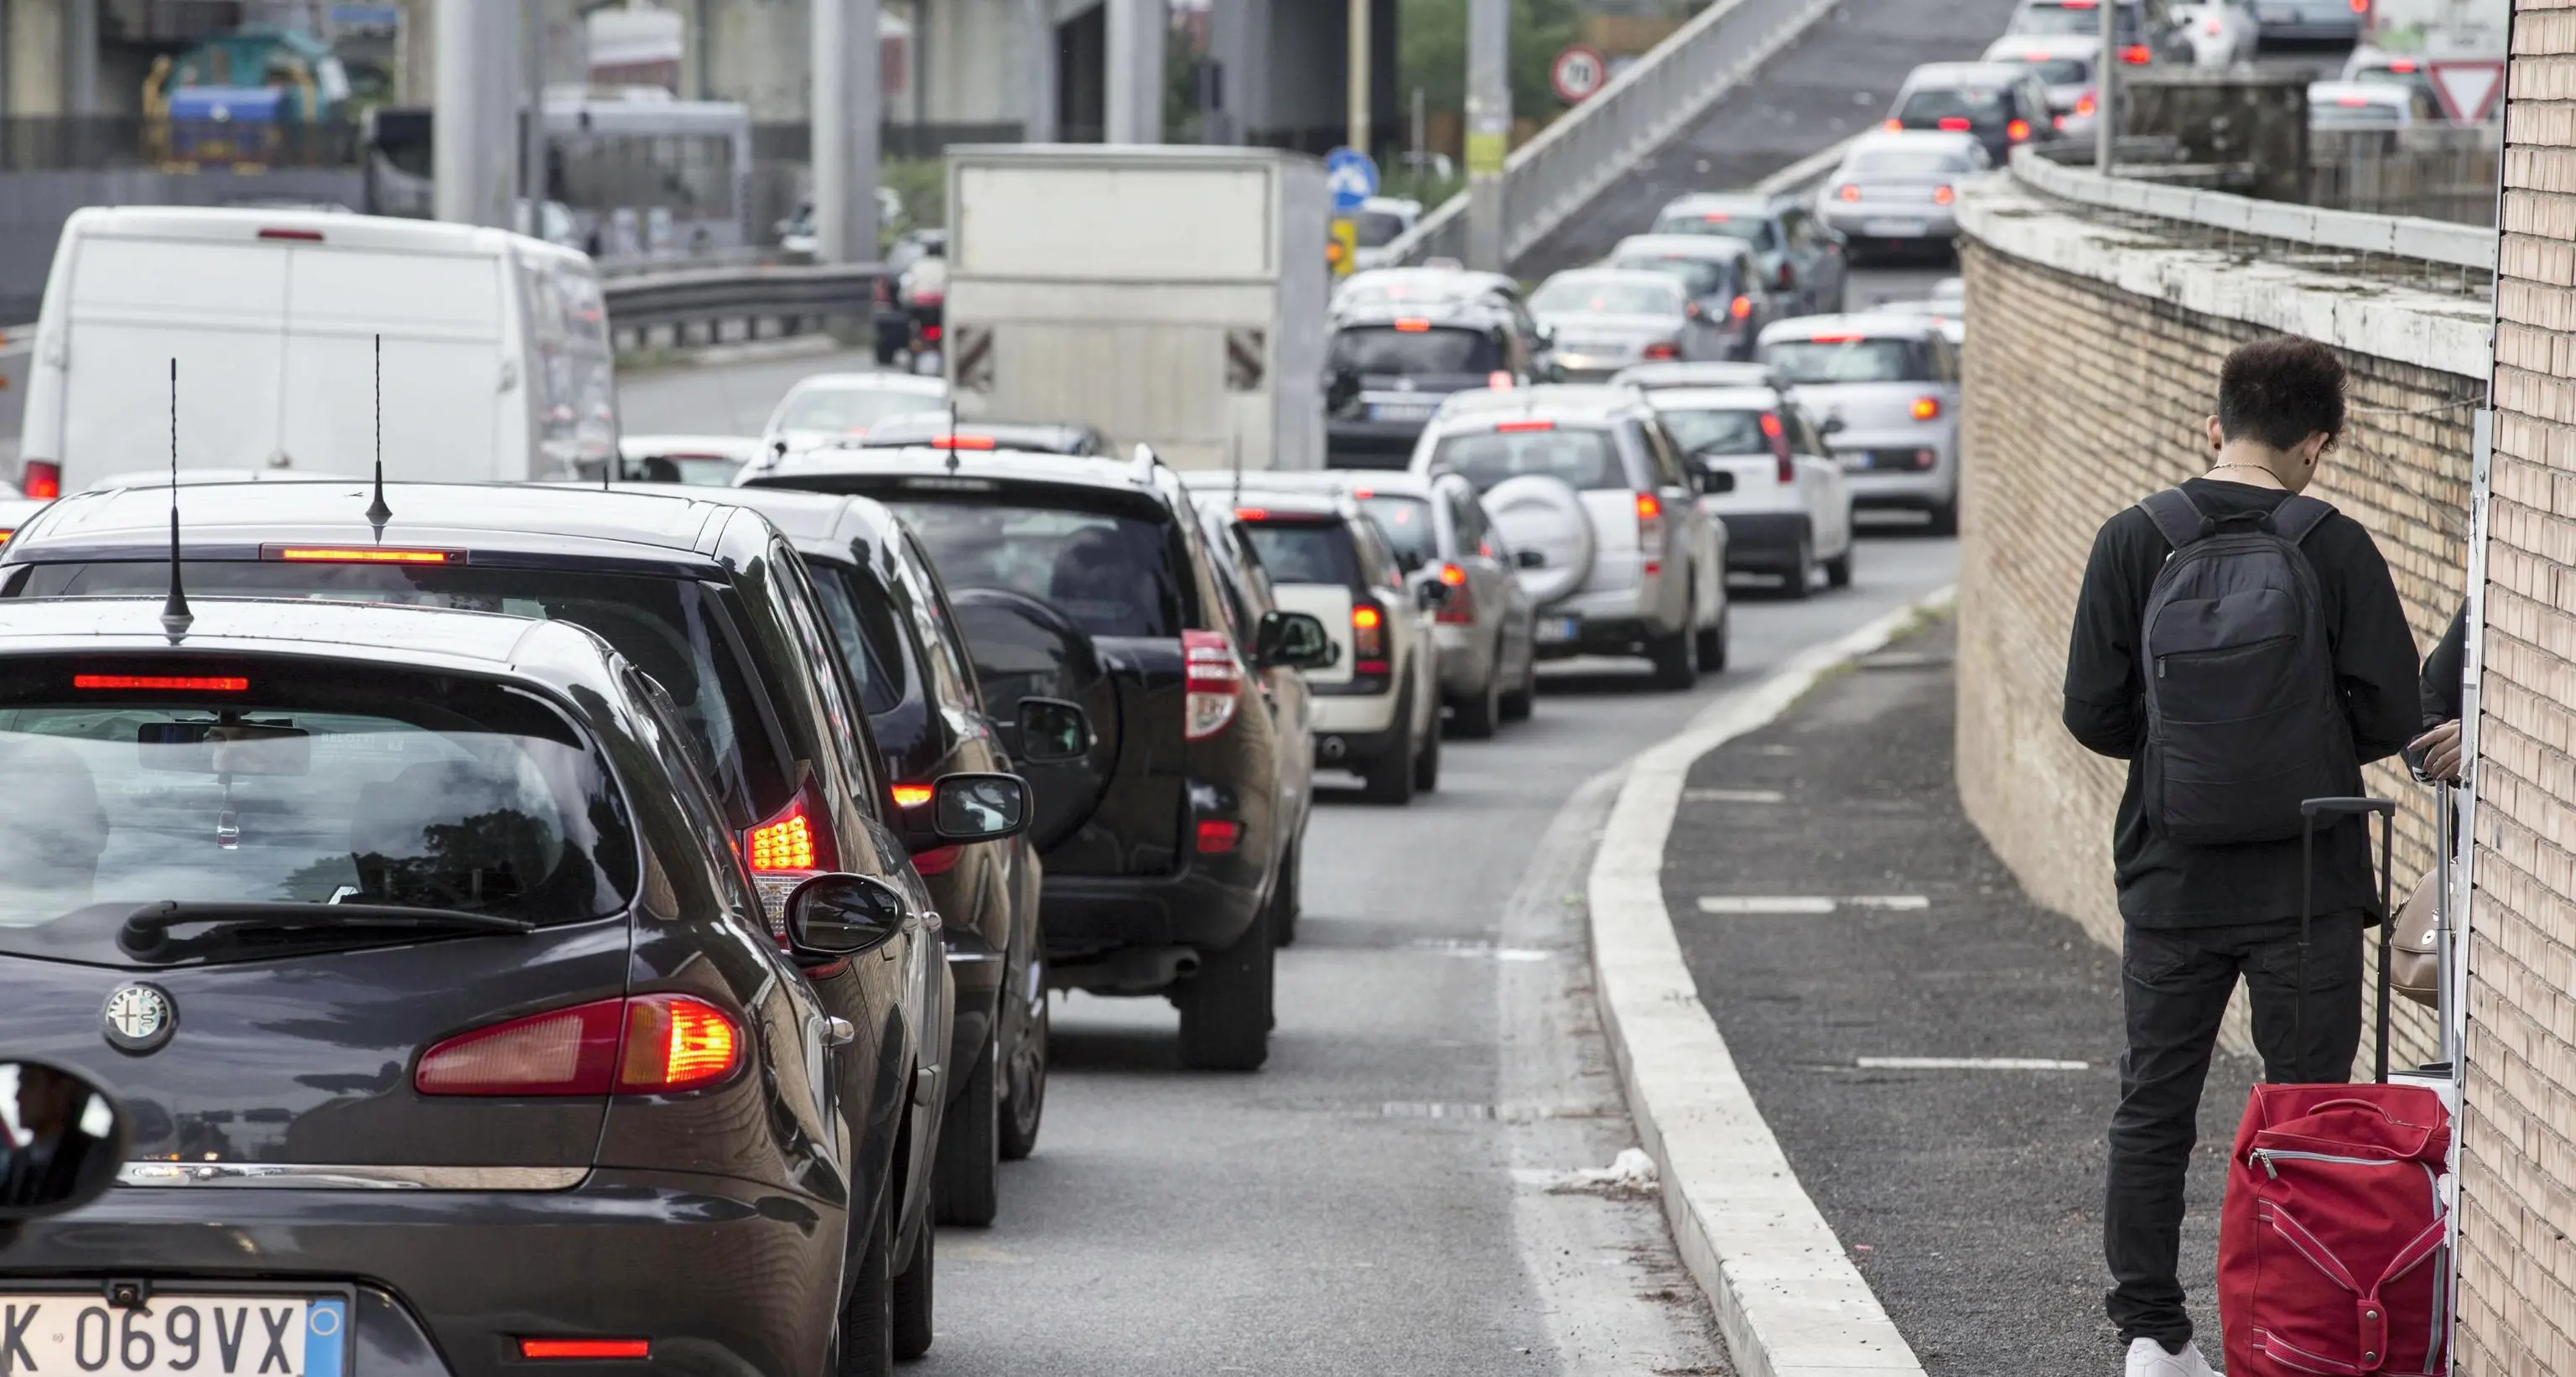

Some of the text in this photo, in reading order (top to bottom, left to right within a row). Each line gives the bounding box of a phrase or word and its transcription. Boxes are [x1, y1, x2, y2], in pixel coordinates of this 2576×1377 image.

[107, 987, 167, 1018] ALFA ROMEO
[75, 1305, 293, 1374] 069VX
